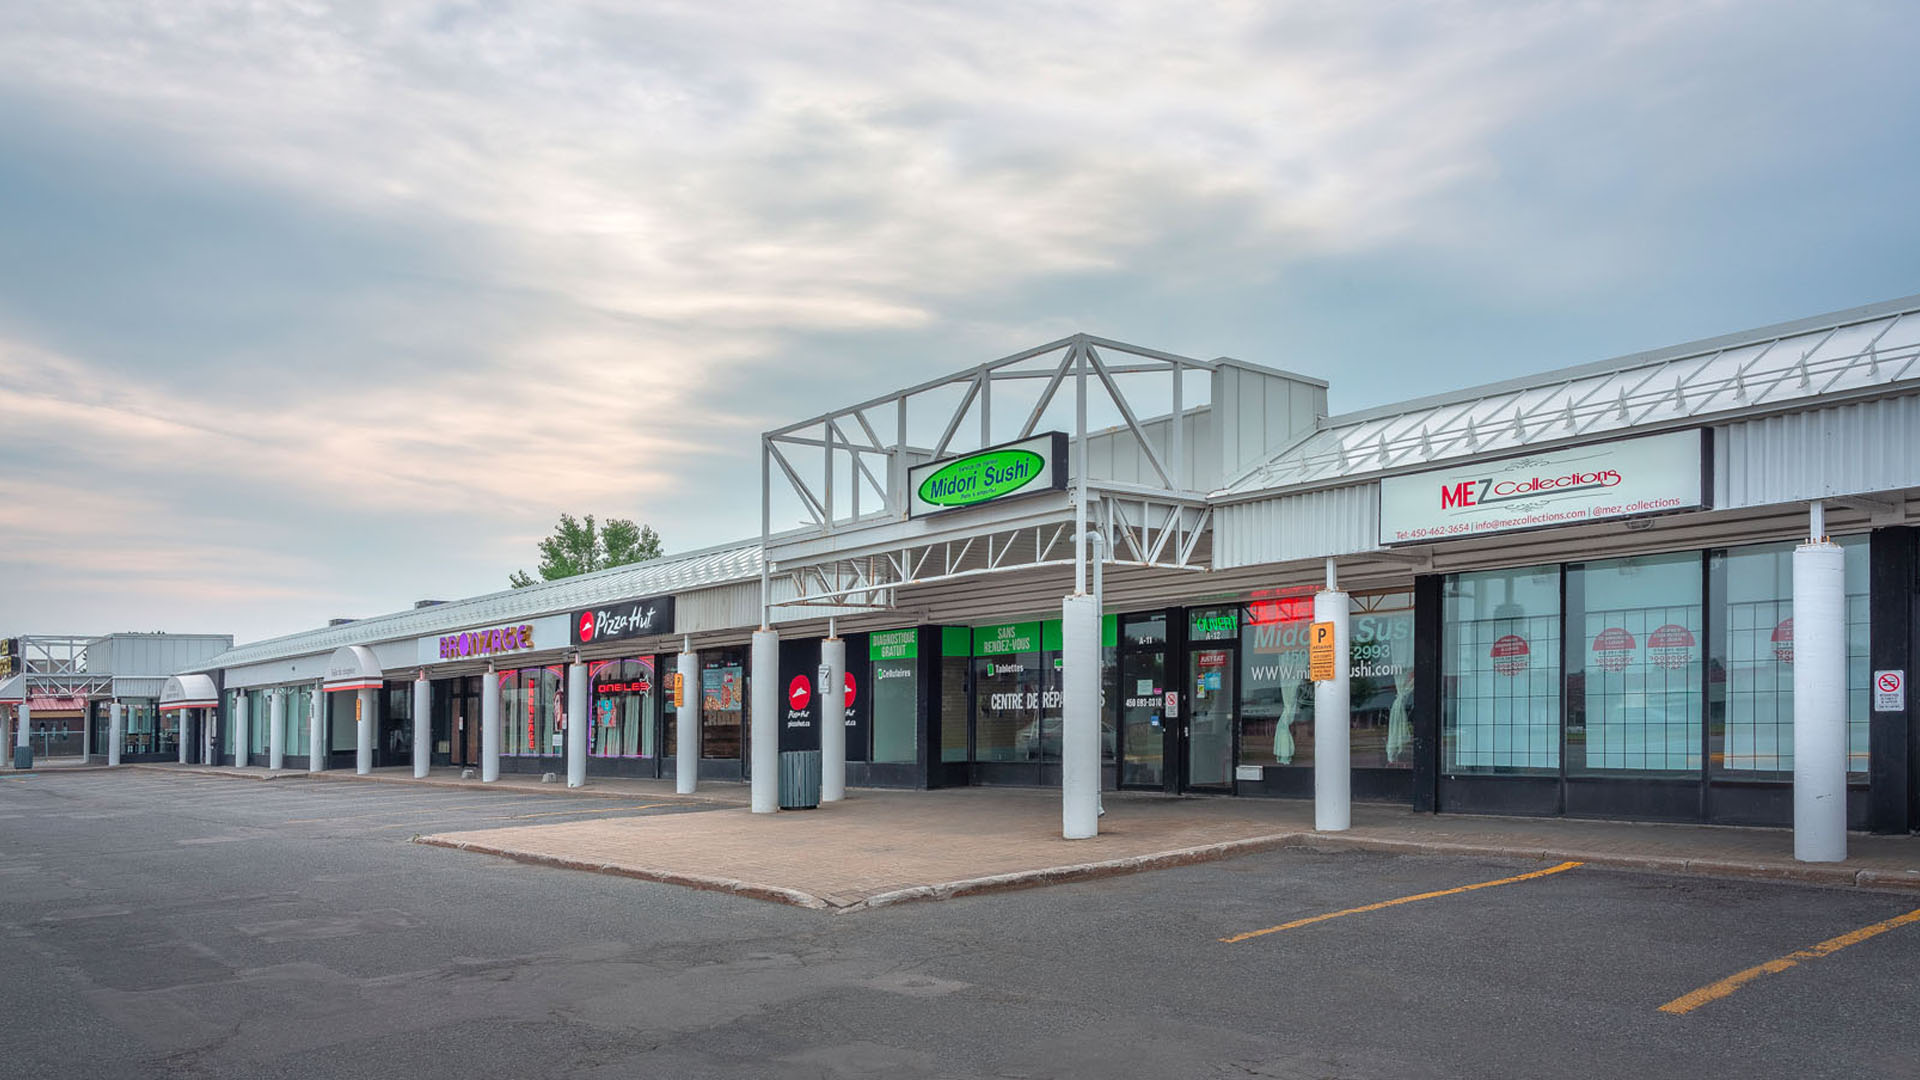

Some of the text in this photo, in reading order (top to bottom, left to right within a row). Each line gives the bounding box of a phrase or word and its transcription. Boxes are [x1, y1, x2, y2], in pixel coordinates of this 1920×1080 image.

[930, 471, 977, 499] Midori
[984, 457, 1030, 487] Sushi
[1441, 469, 1622, 510] MEZ Collections
[1411, 523, 1469, 538] 450-462-3654
[1475, 509, 1586, 529] info@mezcollections.com
[1593, 498, 1680, 516] @mez_collections
[1248, 596, 1314, 625] SUSH
[595, 605, 656, 640] Pizza Hut
[1196, 615, 1237, 632] OUVERT
[873, 631, 915, 647] DIAGNOSTIQUE
[997, 626, 1016, 640] SANS
[1253, 617, 1408, 649] Mido Sus
[1318, 628, 1326, 643] P
[440, 624, 532, 660] BRONZAGE
[983, 637, 1031, 653] RENDEZ-VOUS
[881, 645, 906, 658] GRATUIT
[882, 668, 911, 678] Cellulaires
[995, 664, 1024, 673] Tablettes
[991, 693, 1023, 710] CENTRE
[1027, 692, 1039, 709] DE
